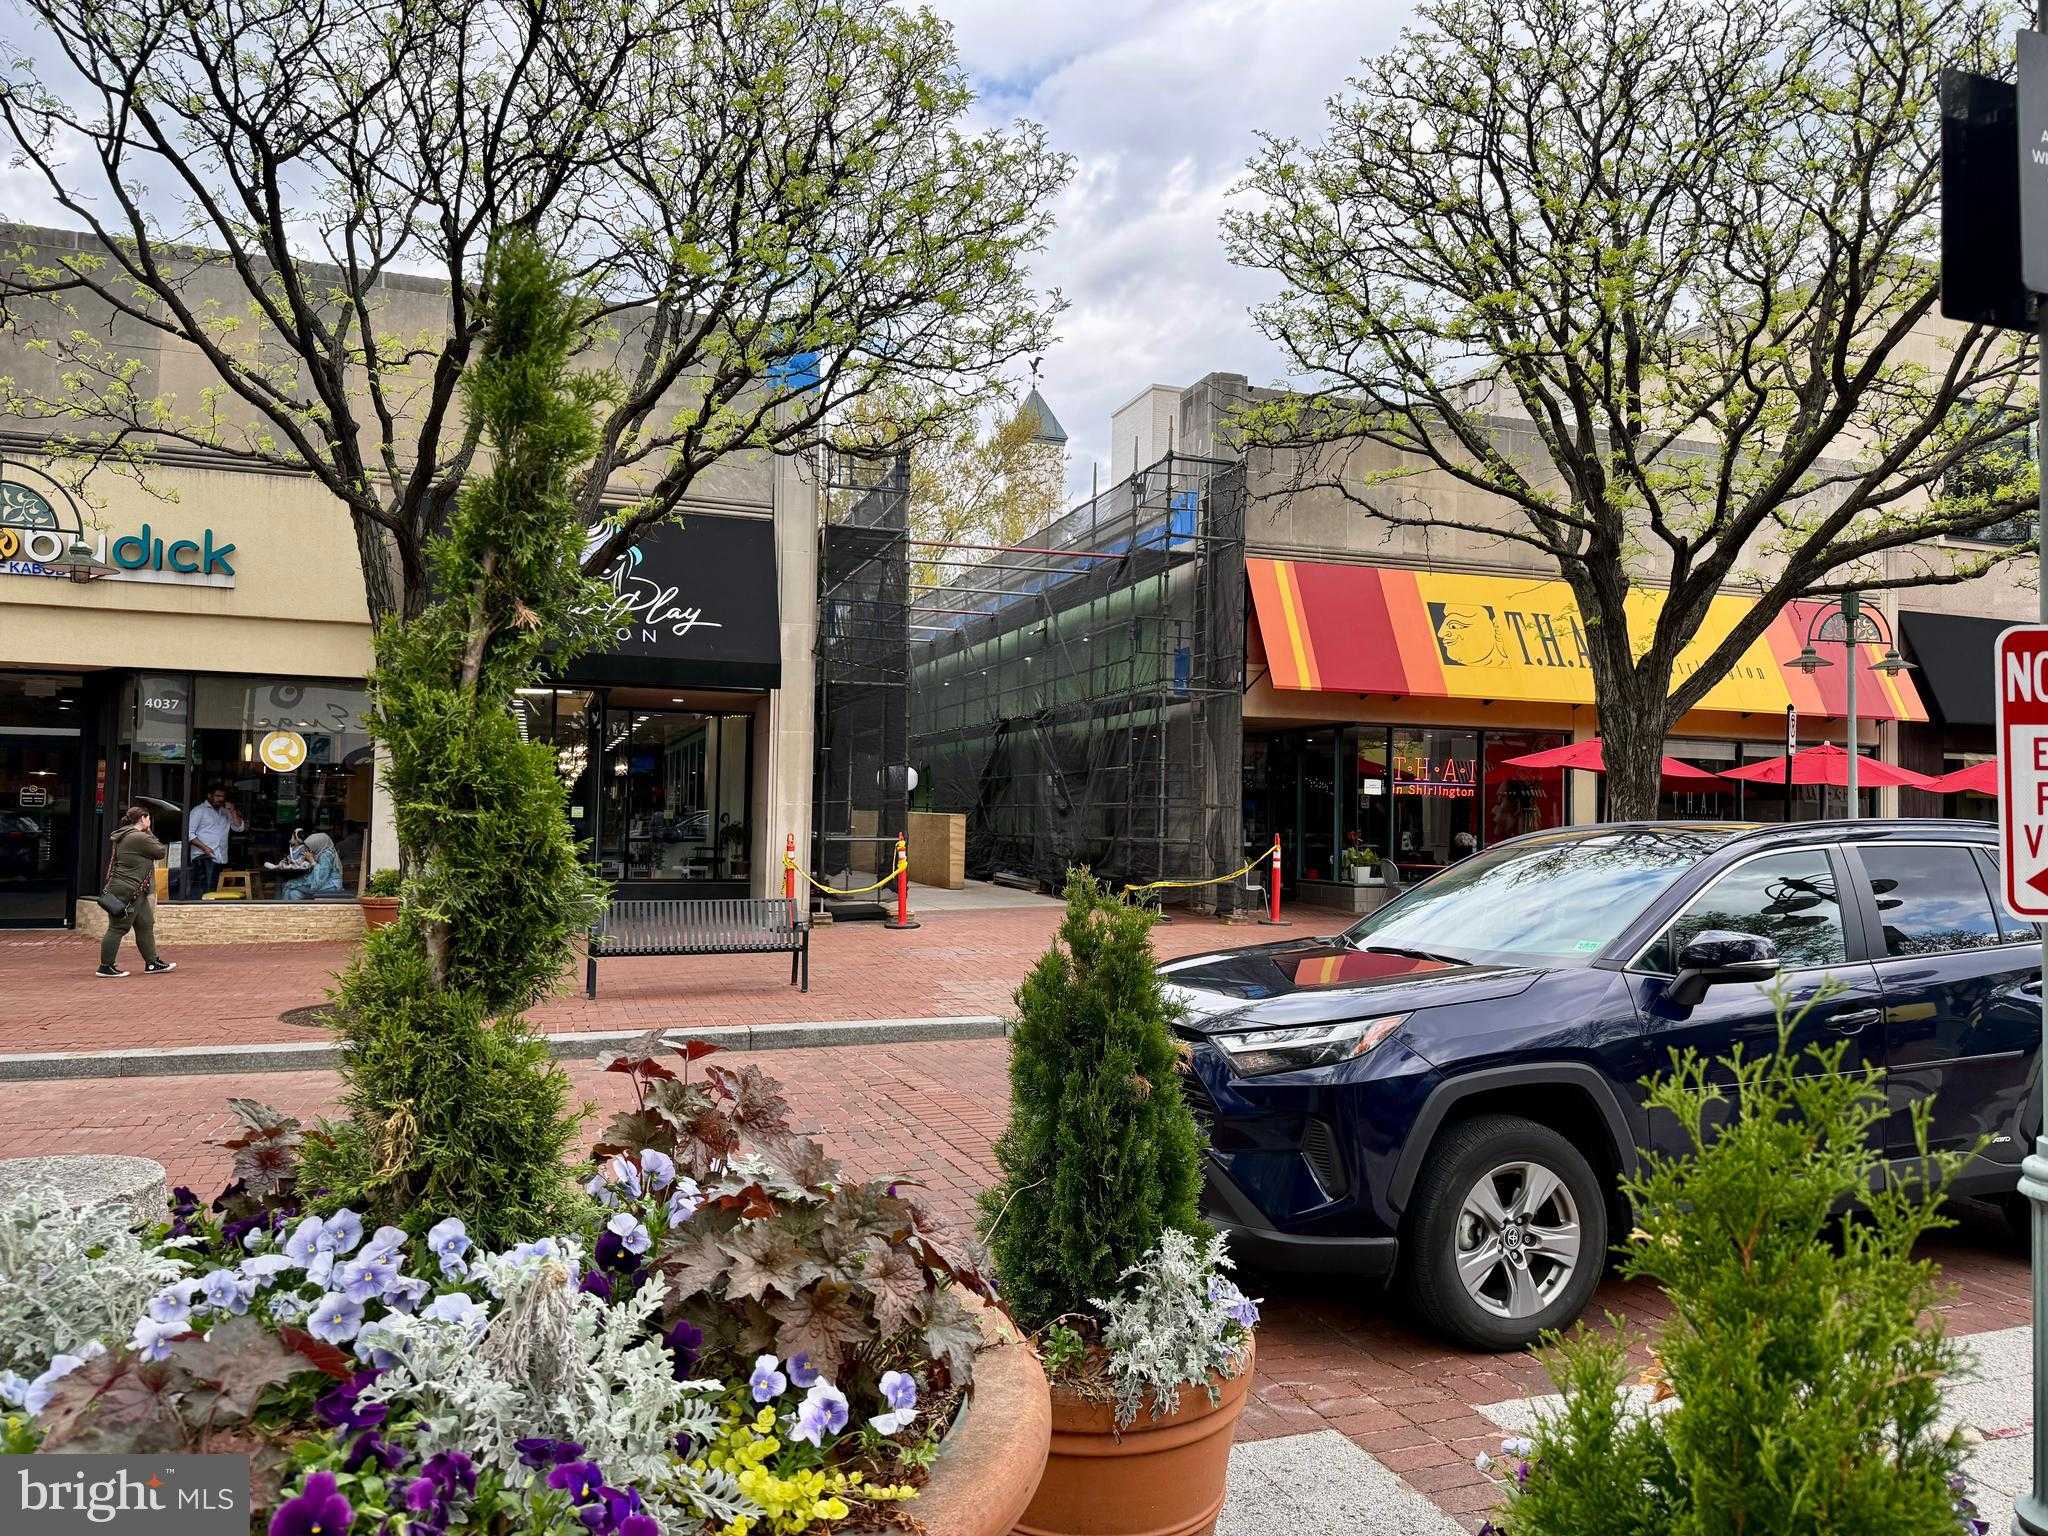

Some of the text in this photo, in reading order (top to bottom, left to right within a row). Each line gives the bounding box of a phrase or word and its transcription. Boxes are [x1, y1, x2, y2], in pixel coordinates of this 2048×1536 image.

[112, 523, 236, 576] dick
[10, 561, 66, 575] KAB
[144, 698, 180, 710] 4037
[1392, 784, 1403, 796] in
[1407, 784, 1475, 799] Shirlington
